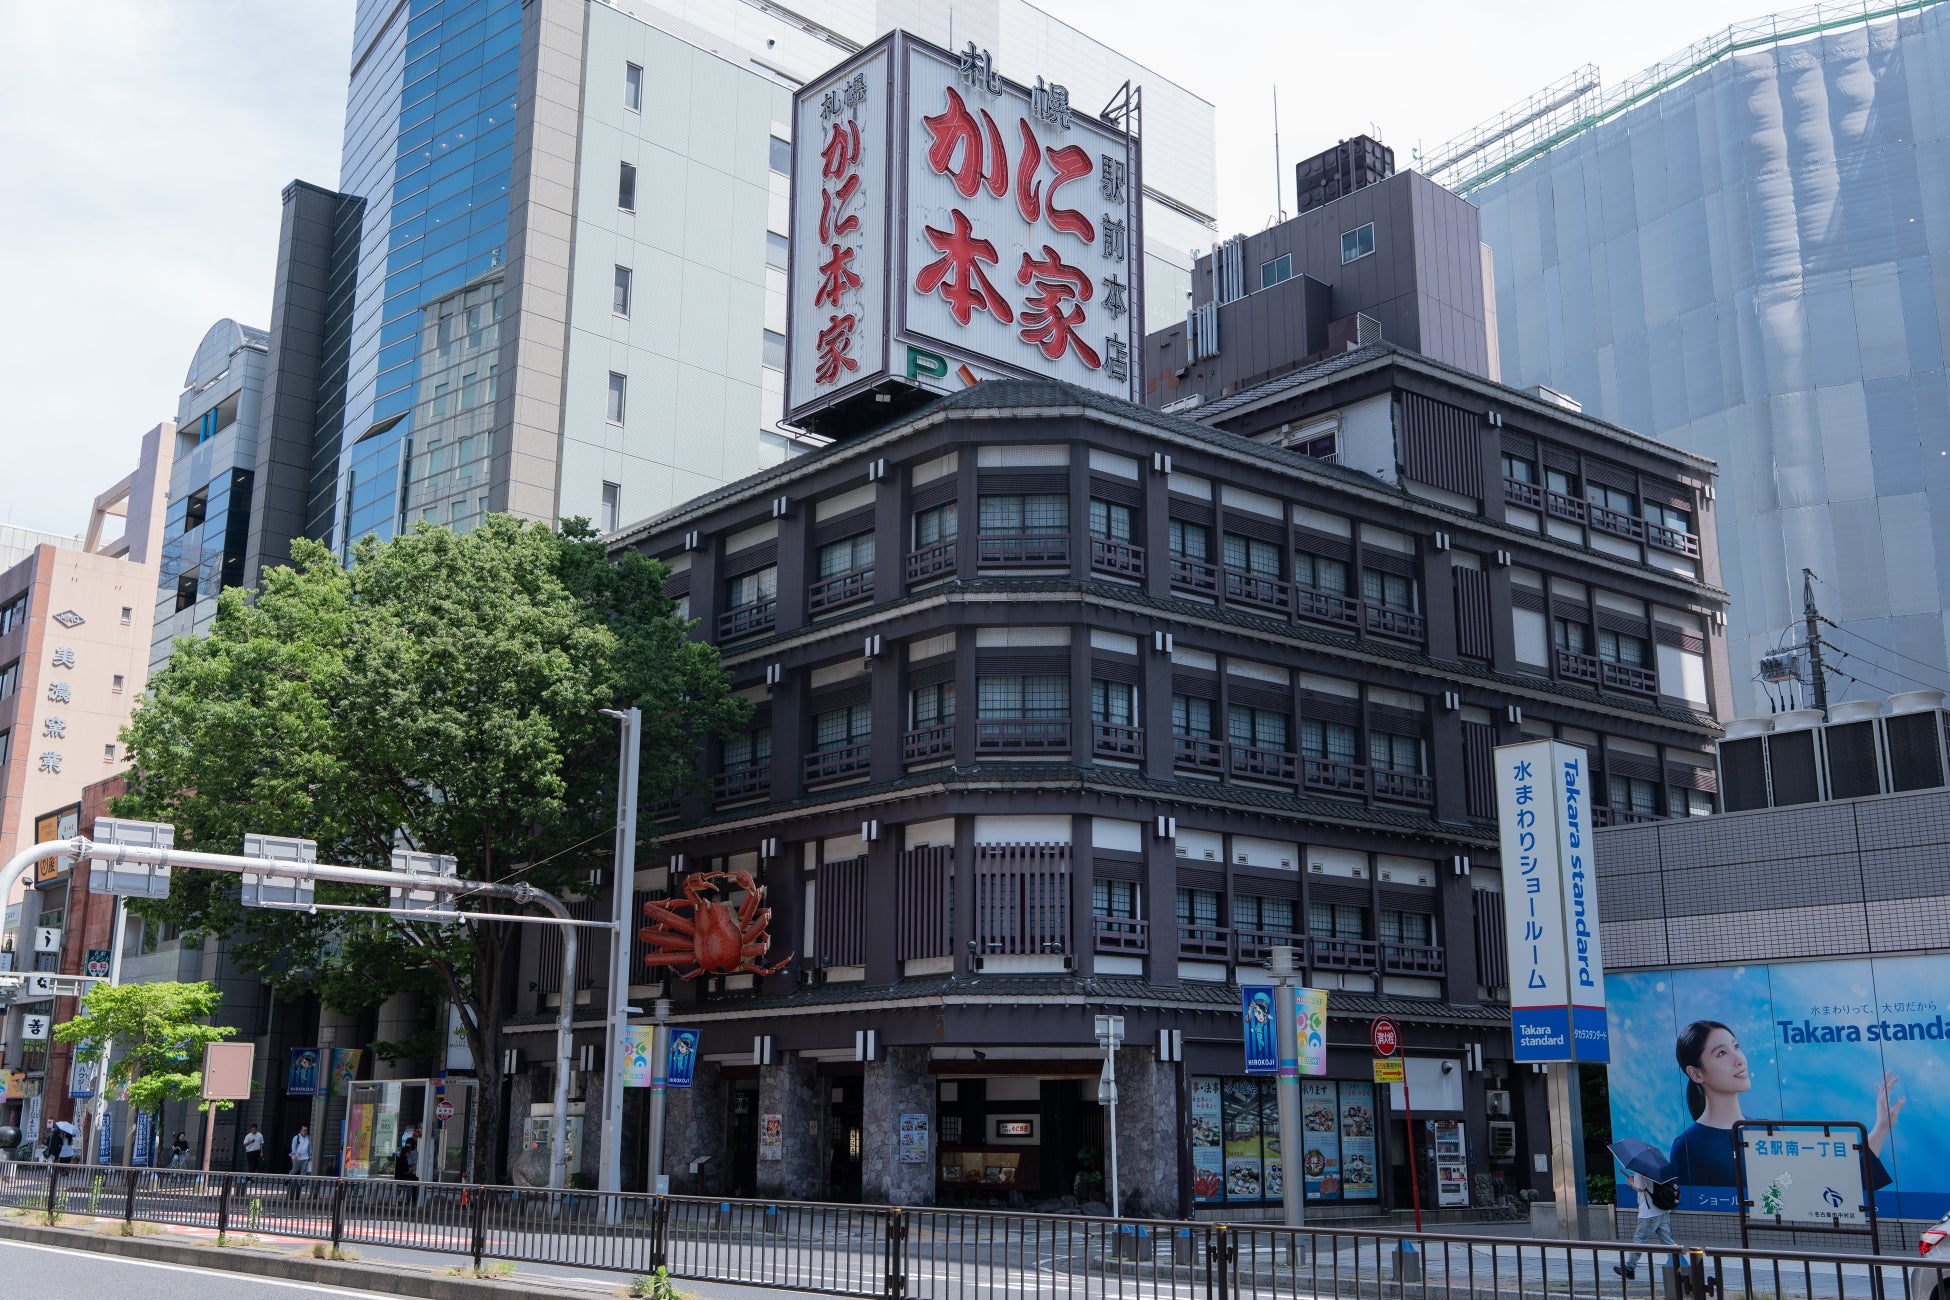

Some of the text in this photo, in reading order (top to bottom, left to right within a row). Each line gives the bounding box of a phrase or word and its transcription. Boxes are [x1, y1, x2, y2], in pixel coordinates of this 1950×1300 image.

[820, 72, 867, 120] 札幌
[960, 41, 1073, 131] 札幌
[923, 85, 1096, 244] かに
[815, 119, 862, 384] かに本家
[1100, 152, 1128, 384] 駅前本店
[914, 208, 1102, 370] 本家
[38, 646, 75, 774] 美濃窯業
[1513, 760, 1547, 989] 水まわりショールーム
[1563, 758, 1594, 987] Takara standard
[1248, 1059, 1276, 1067] HIROKOJI
[1377, 1032, 1395, 1045] 消火栓
[1520, 1024, 1551, 1035] Takara
[1520, 1035, 1565, 1046] standard
[1574, 1029, 1608, 1041] タカラスタンダード
[1777, 1020, 1861, 1044] Takara
[1755, 1139, 1848, 1158] 名駅南一丁目
